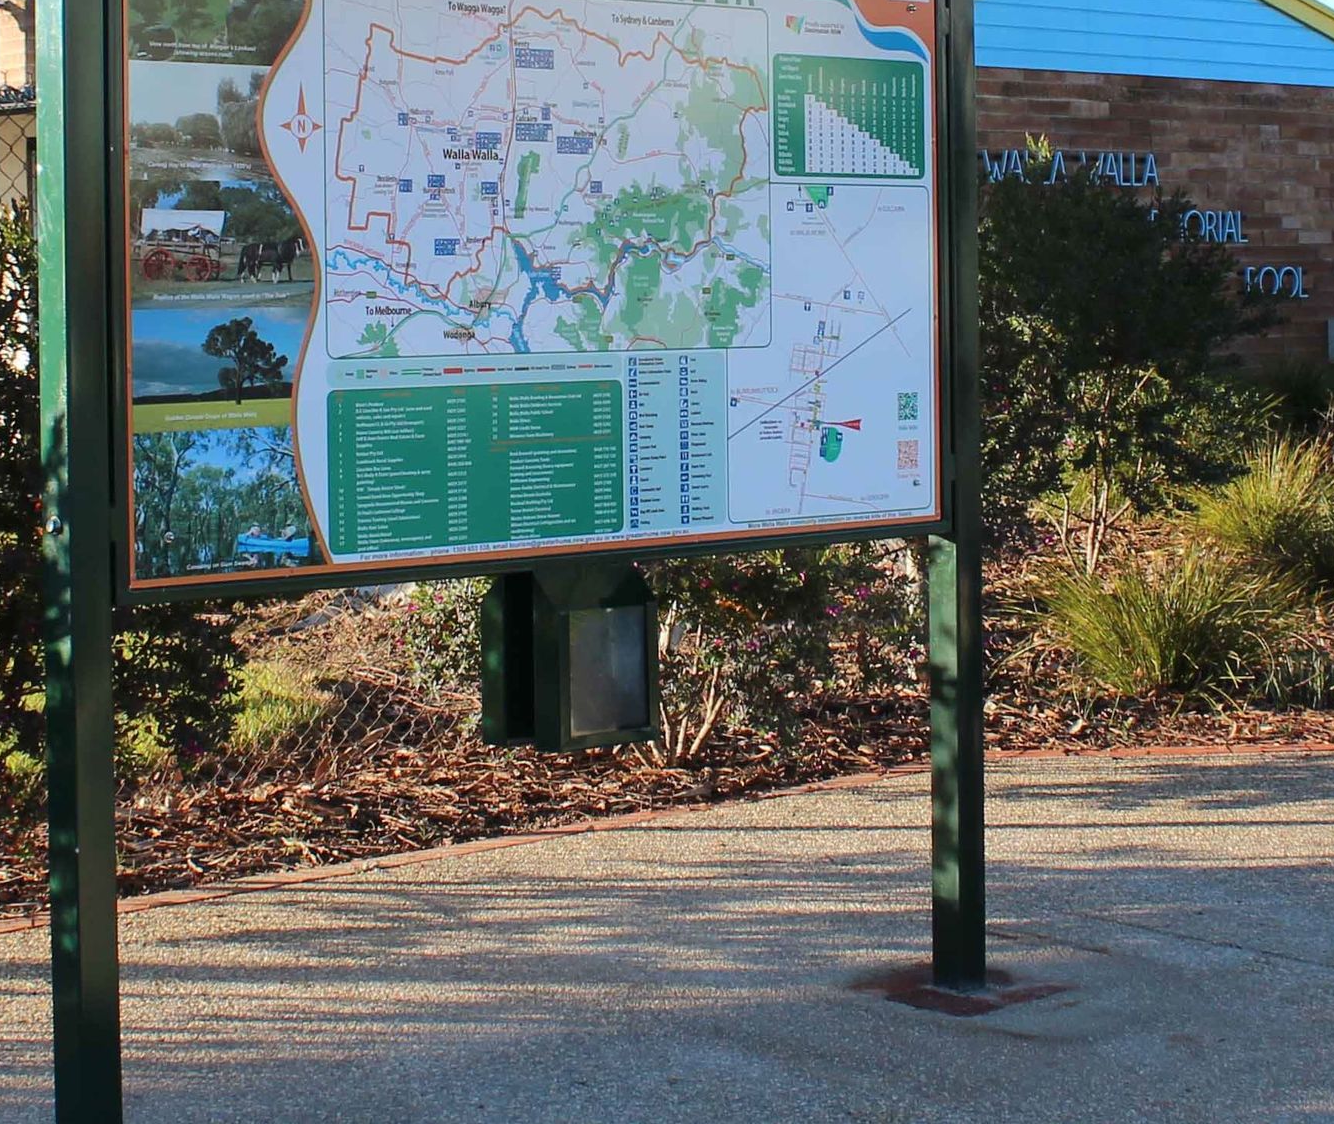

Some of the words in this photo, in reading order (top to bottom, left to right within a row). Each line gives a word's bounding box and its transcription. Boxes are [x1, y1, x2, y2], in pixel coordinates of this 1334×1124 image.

[448, 1, 457, 11] To
[457, 2, 480, 15] Wagga
[480, 4, 504, 16] Wagga
[612, 13, 619, 23] To
[620, 14, 641, 26] Sydney
[648, 16, 675, 26] Canberra
[297, 120, 306, 133] N
[442, 148, 470, 160] Walla
[471, 150, 499, 161] Walla
[982, 149, 1067, 185] WAA
[366, 306, 374, 315] To
[374, 306, 412, 316] Melbourne
[469, 300, 491, 310] Albury
[443, 330, 475, 340] Wodonga
